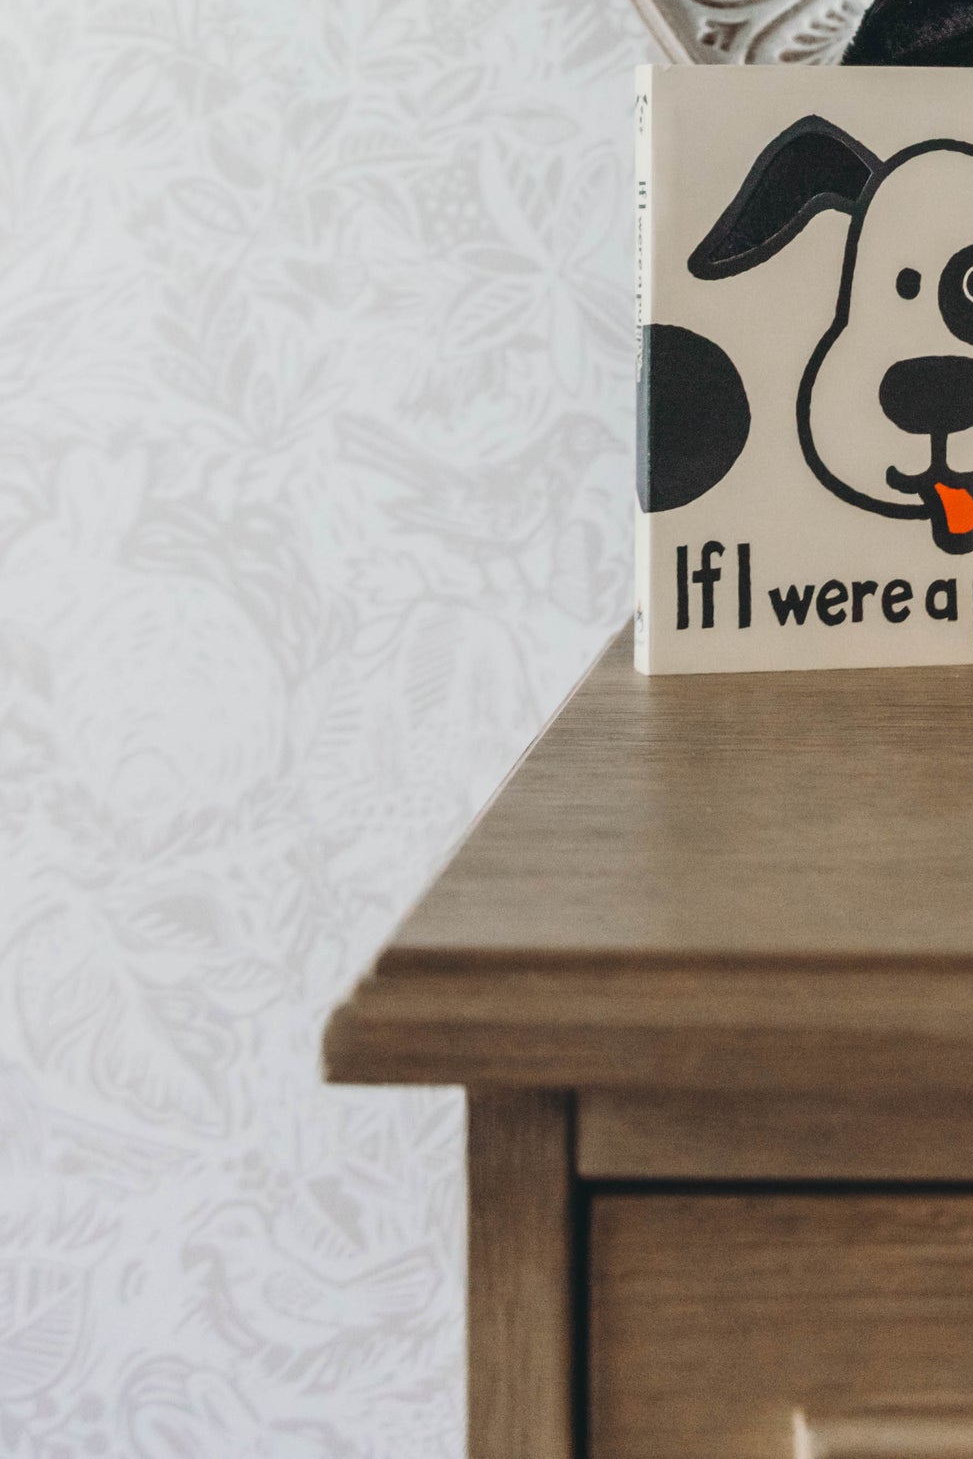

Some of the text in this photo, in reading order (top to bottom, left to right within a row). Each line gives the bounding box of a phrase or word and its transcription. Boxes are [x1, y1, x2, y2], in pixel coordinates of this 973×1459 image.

[676, 540, 726, 631] If
[737, 542, 752, 631] I
[767, 576, 914, 627] were
[924, 578, 959, 622] a
